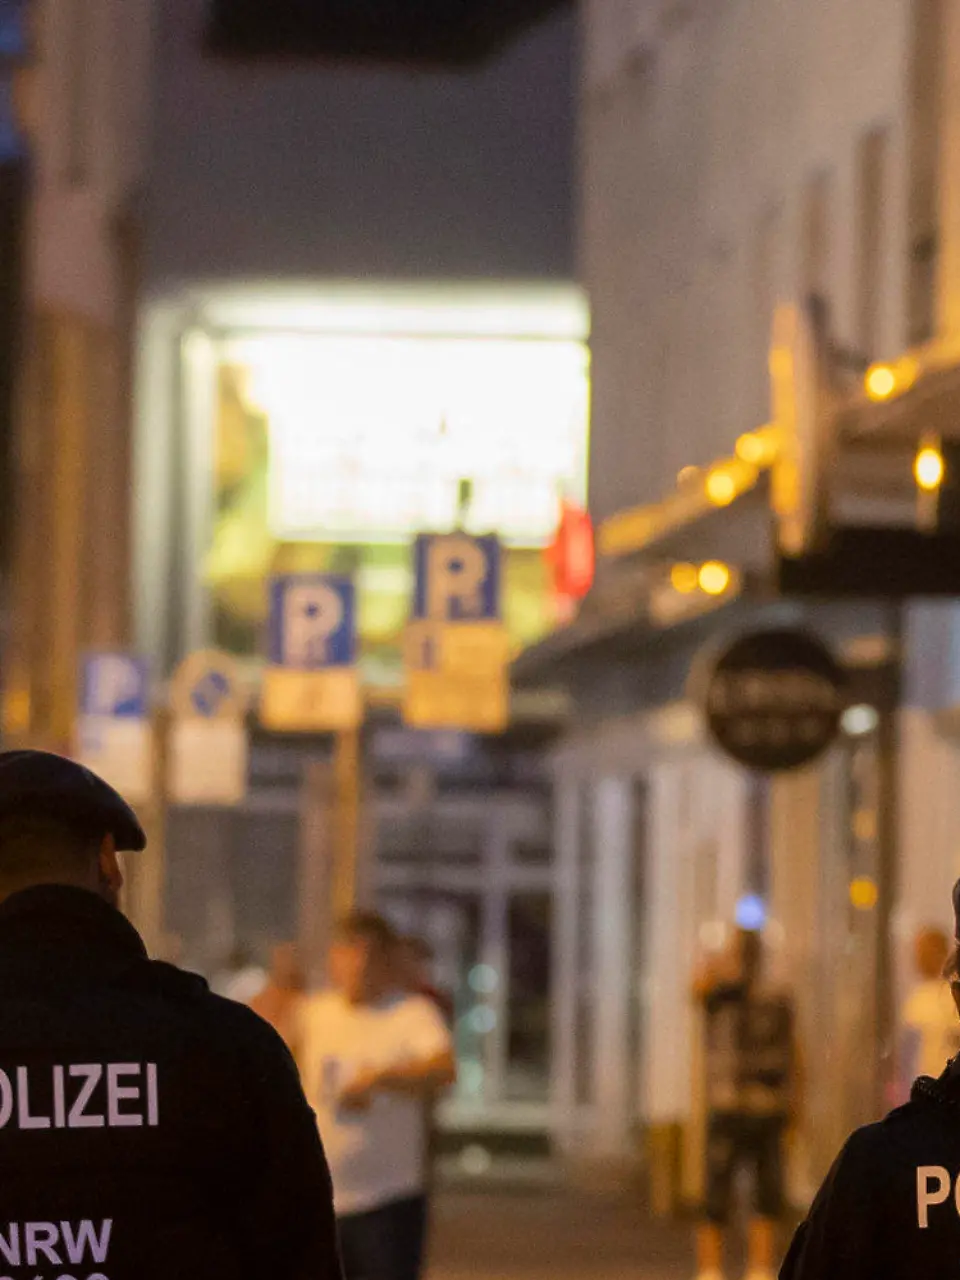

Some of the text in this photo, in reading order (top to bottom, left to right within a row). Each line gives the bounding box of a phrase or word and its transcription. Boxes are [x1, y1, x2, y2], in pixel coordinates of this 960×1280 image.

[282, 584, 343, 666] P
[0, 1062, 159, 1129] LIZEI
[0, 1218, 113, 1266] NRW
